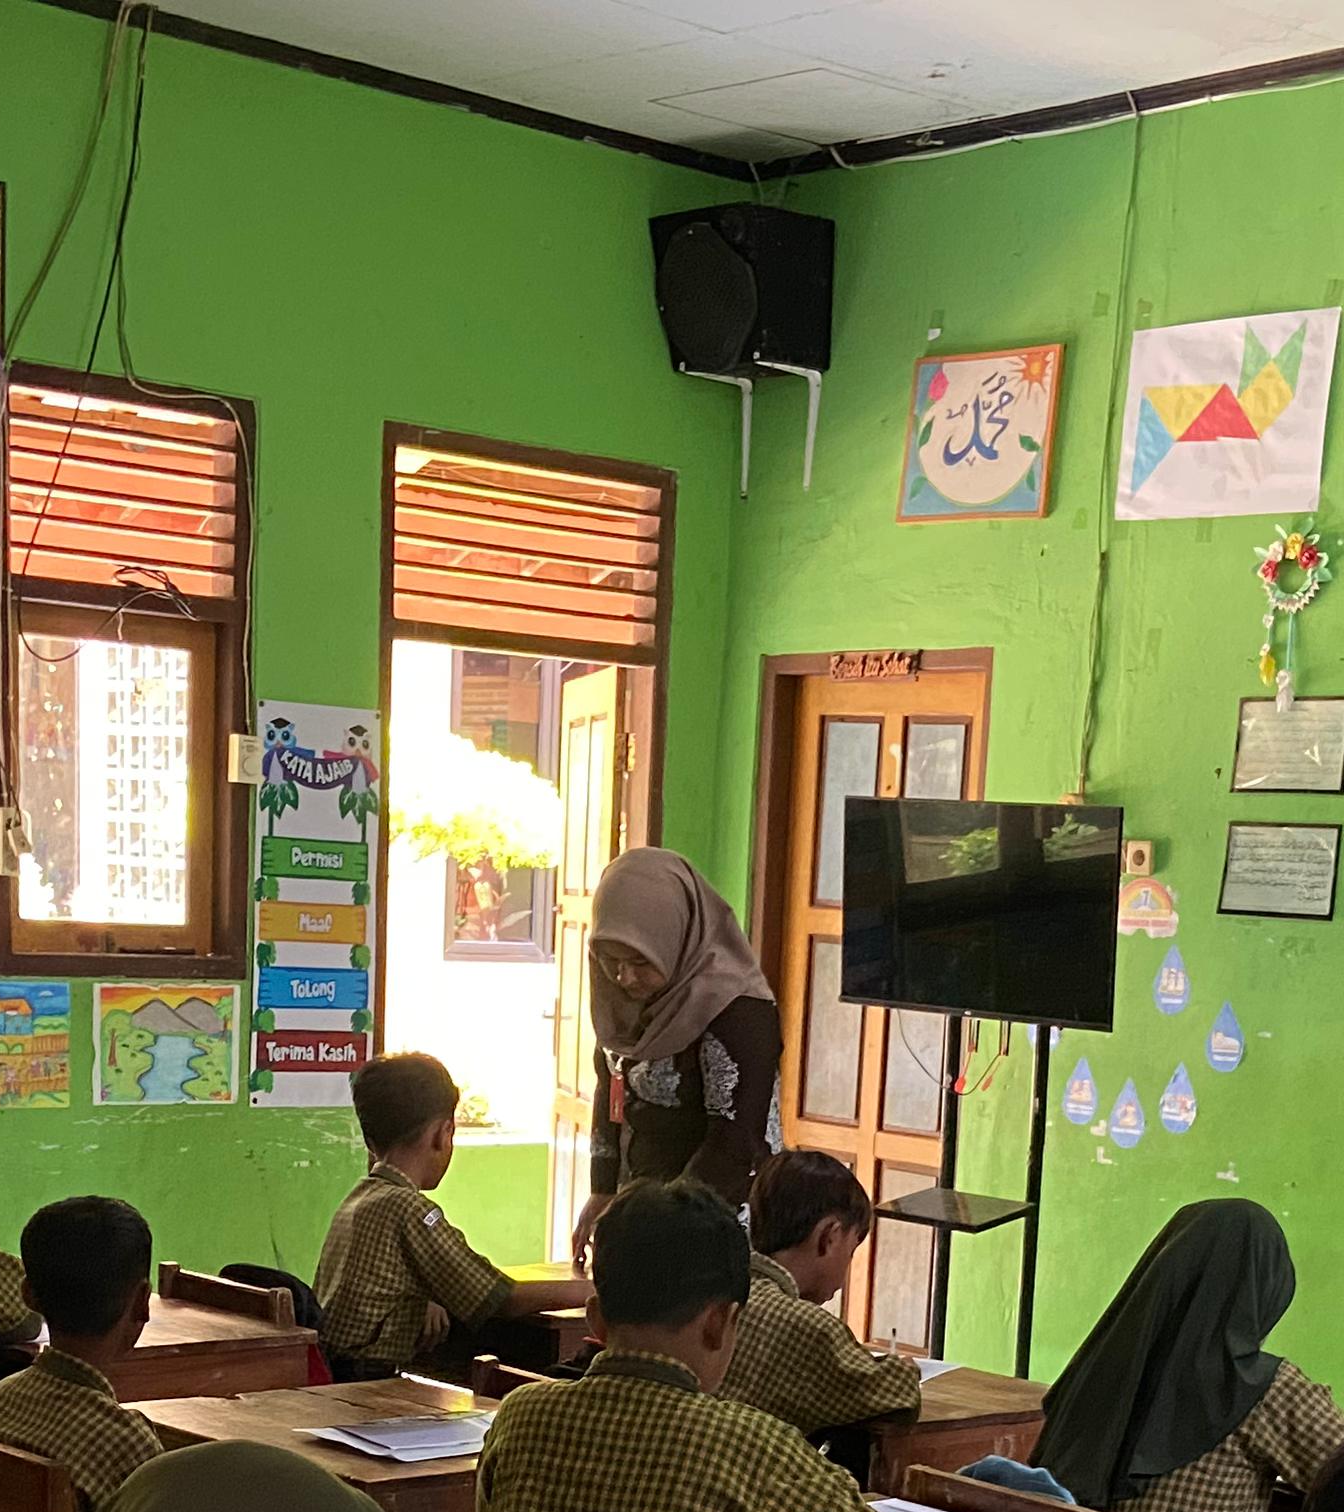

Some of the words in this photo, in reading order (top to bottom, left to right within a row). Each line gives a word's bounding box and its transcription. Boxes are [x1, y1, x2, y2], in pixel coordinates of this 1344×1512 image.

[280, 750, 313, 783] KATA
[315, 759, 354, 784] AJAIB
[291, 846, 344, 870] Permisi
[298, 914, 333, 933] Maaf
[266, 1041, 315, 1063] Terima
[317, 1045, 357, 1064] Kasih
